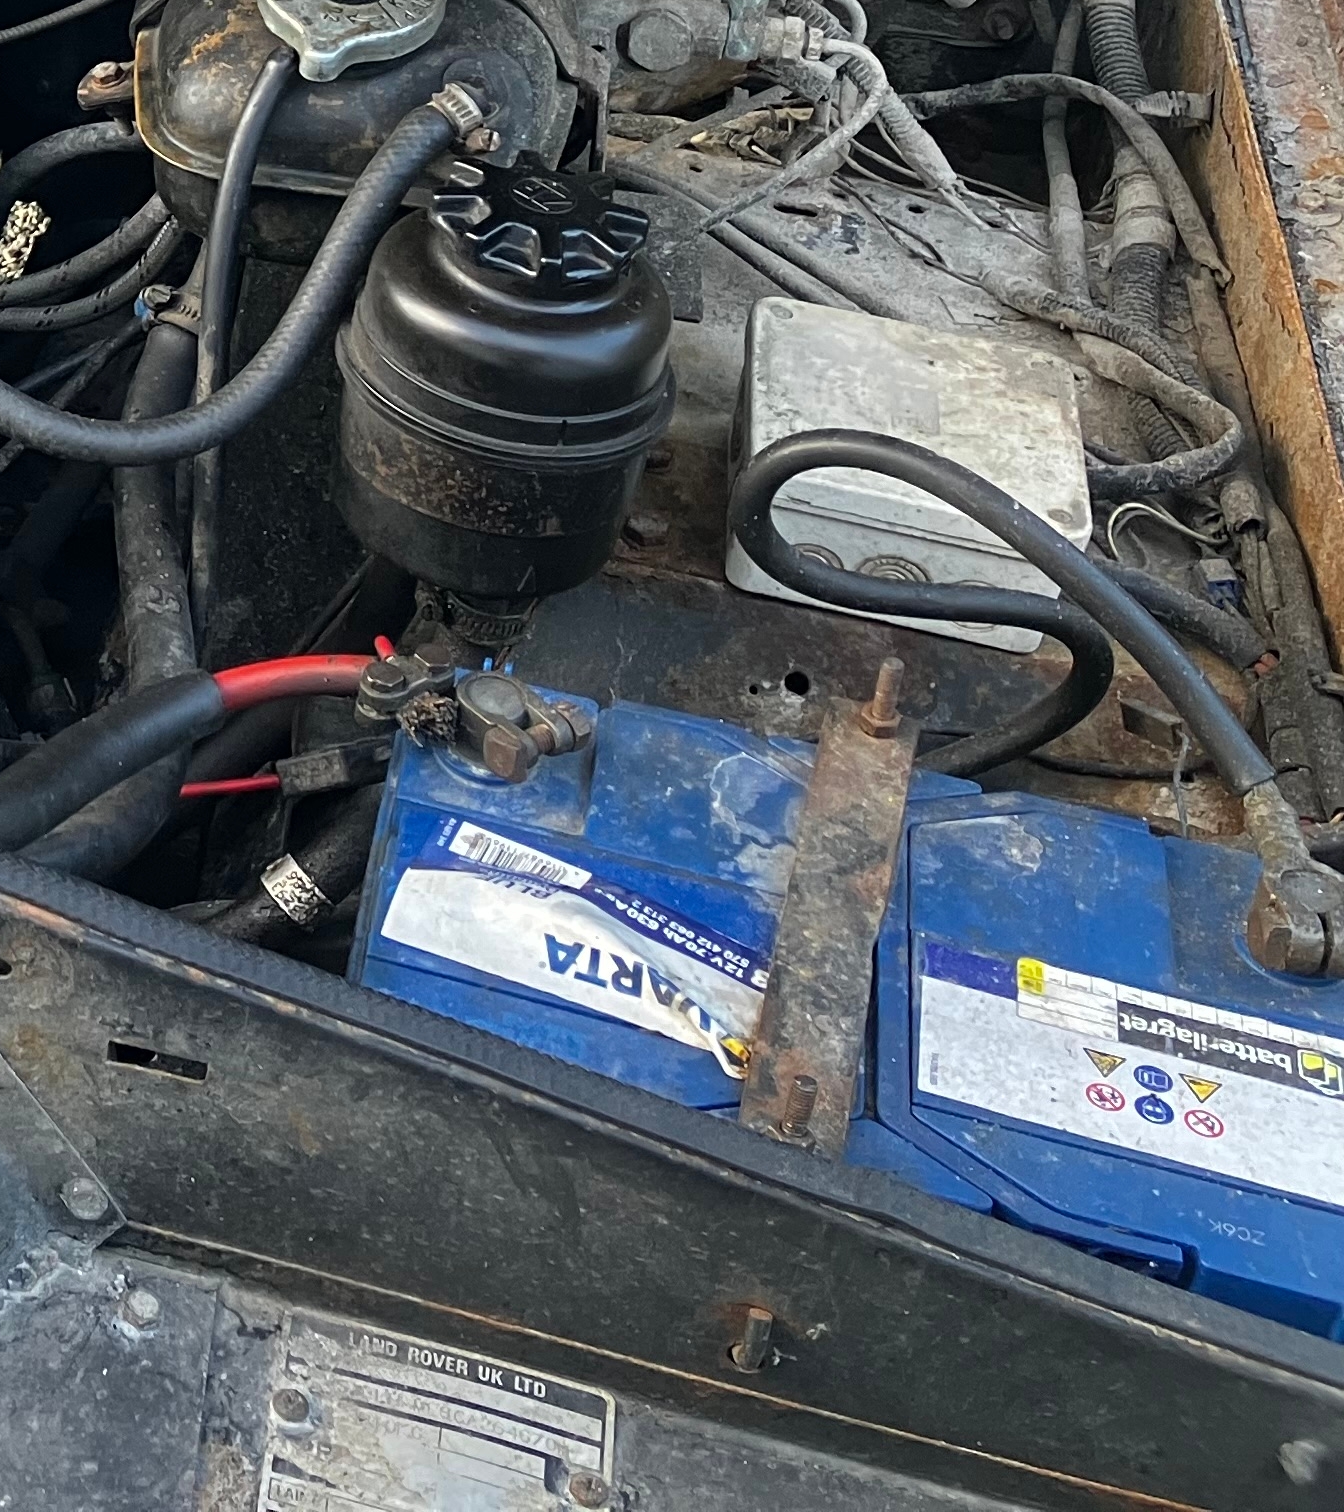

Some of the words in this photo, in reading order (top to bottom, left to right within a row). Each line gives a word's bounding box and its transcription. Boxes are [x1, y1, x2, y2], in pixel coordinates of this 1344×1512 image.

[696, 934, 721, 954] 412
[1119, 1012, 1293, 1074] batterilagret
[348, 1331, 398, 1358] LAND
[407, 1346, 469, 1377] ROVER
[478, 1364, 504, 1387] UK
[514, 1375, 547, 1400] LTD
